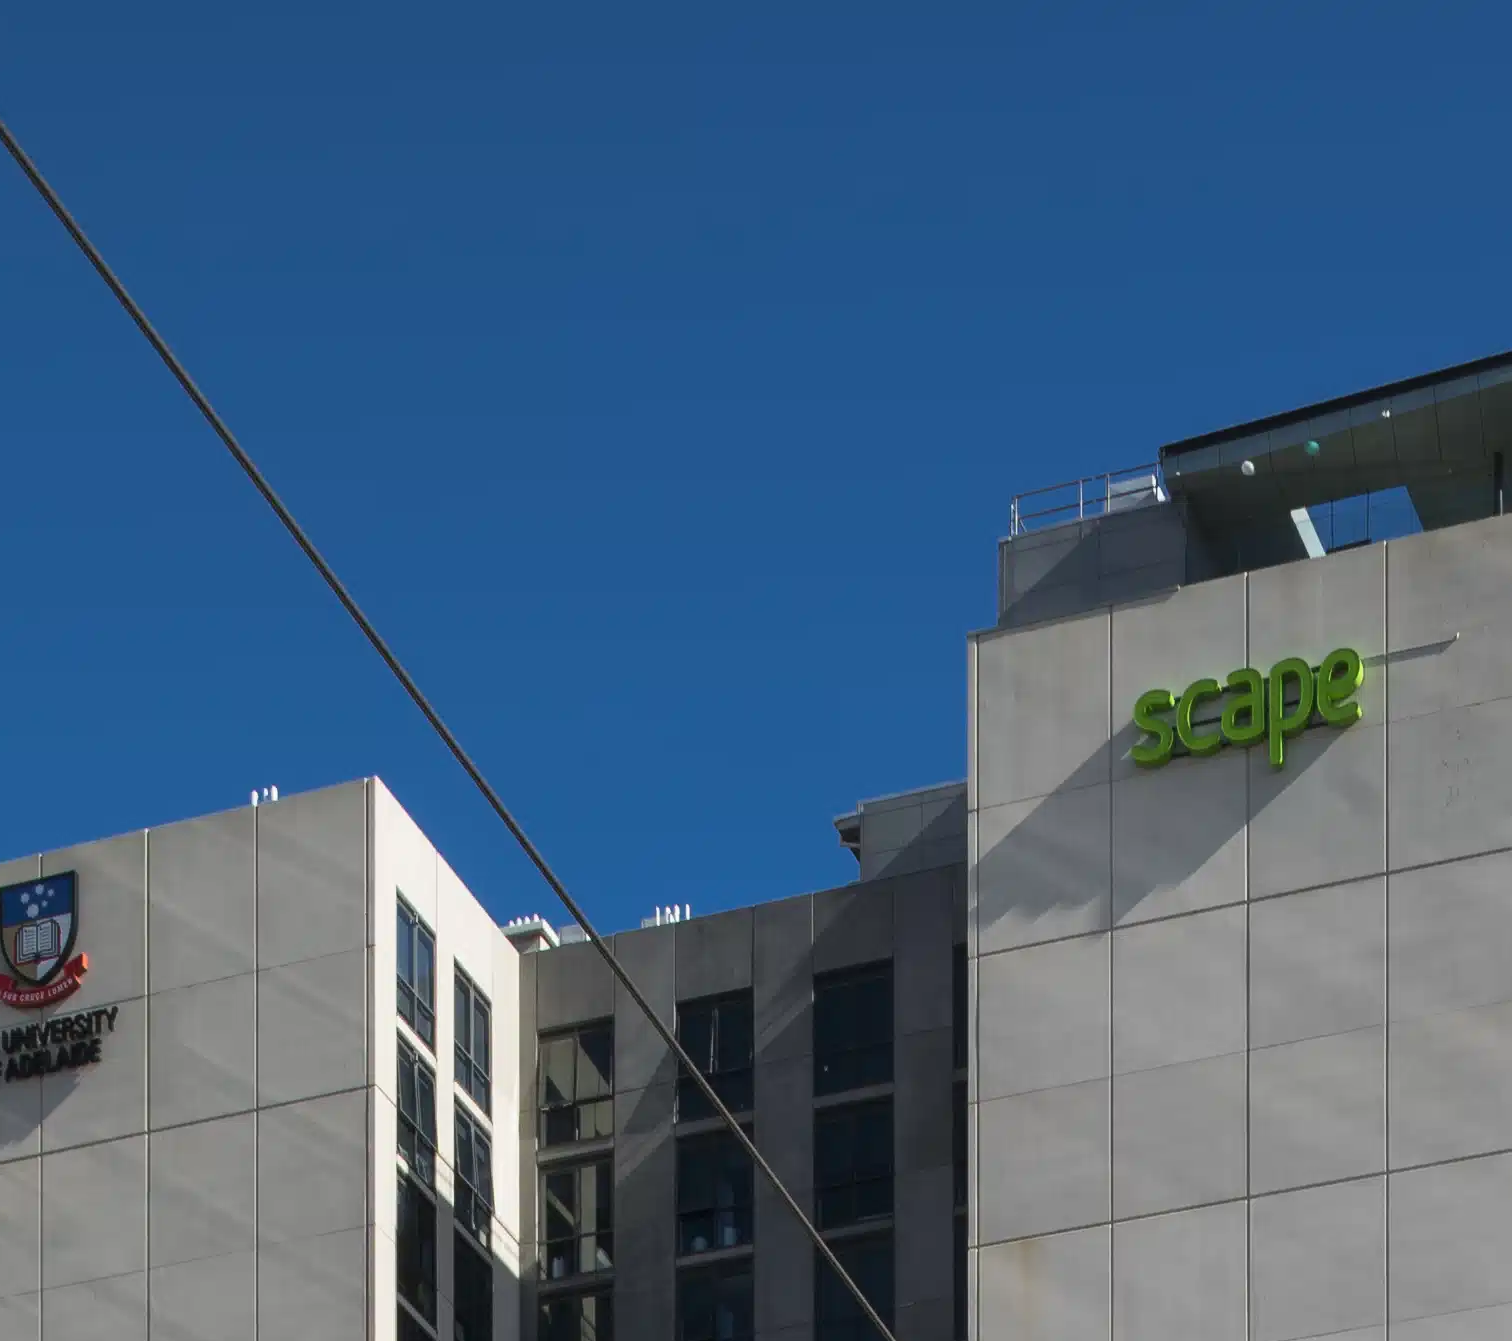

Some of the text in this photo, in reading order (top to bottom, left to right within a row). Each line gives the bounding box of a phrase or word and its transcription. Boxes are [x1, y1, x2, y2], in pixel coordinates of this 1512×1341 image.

[1130, 647, 1364, 769] scape
[1, 1005, 119, 1052] UNIVERSITY
[5, 1037, 102, 1083] ADELAIDE
